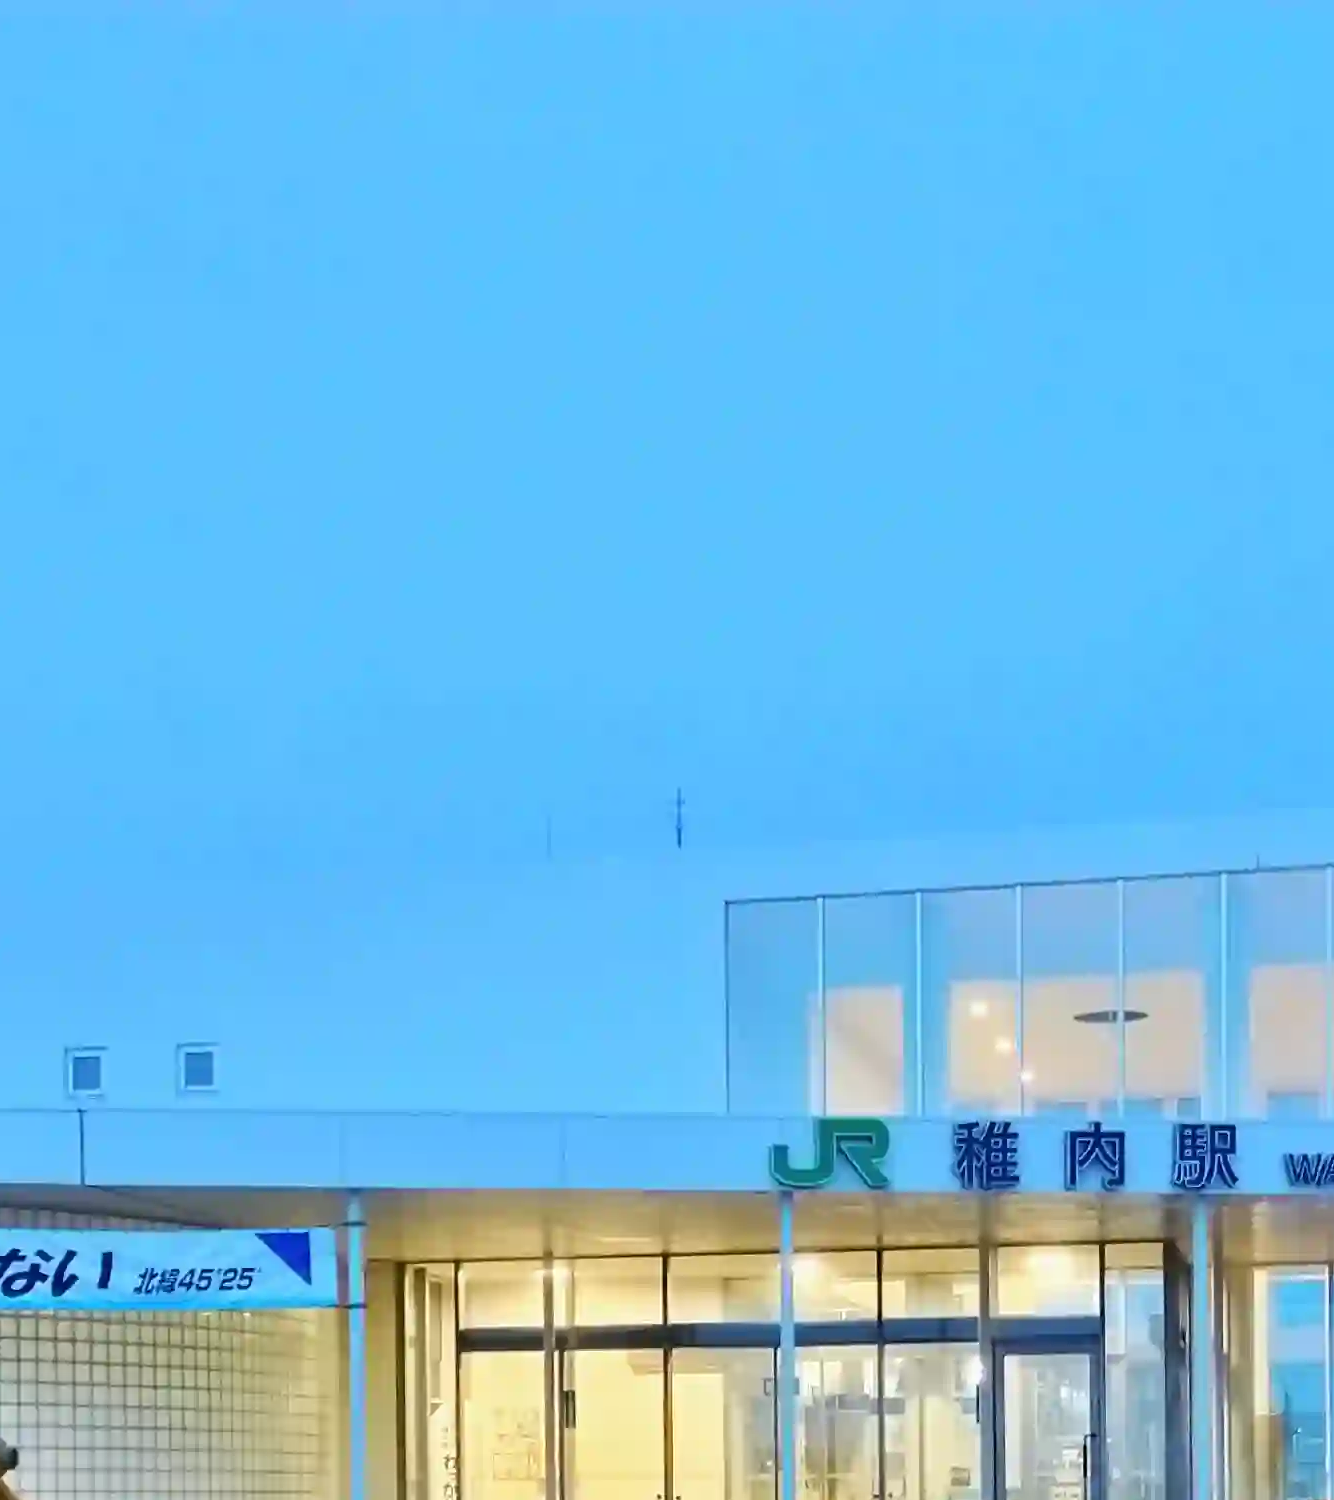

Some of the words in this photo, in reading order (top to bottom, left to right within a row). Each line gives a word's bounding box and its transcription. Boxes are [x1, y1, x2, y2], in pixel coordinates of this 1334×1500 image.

[768, 1118, 889, 1188] JR
[953, 1121, 1239, 1191] 稚内駅
